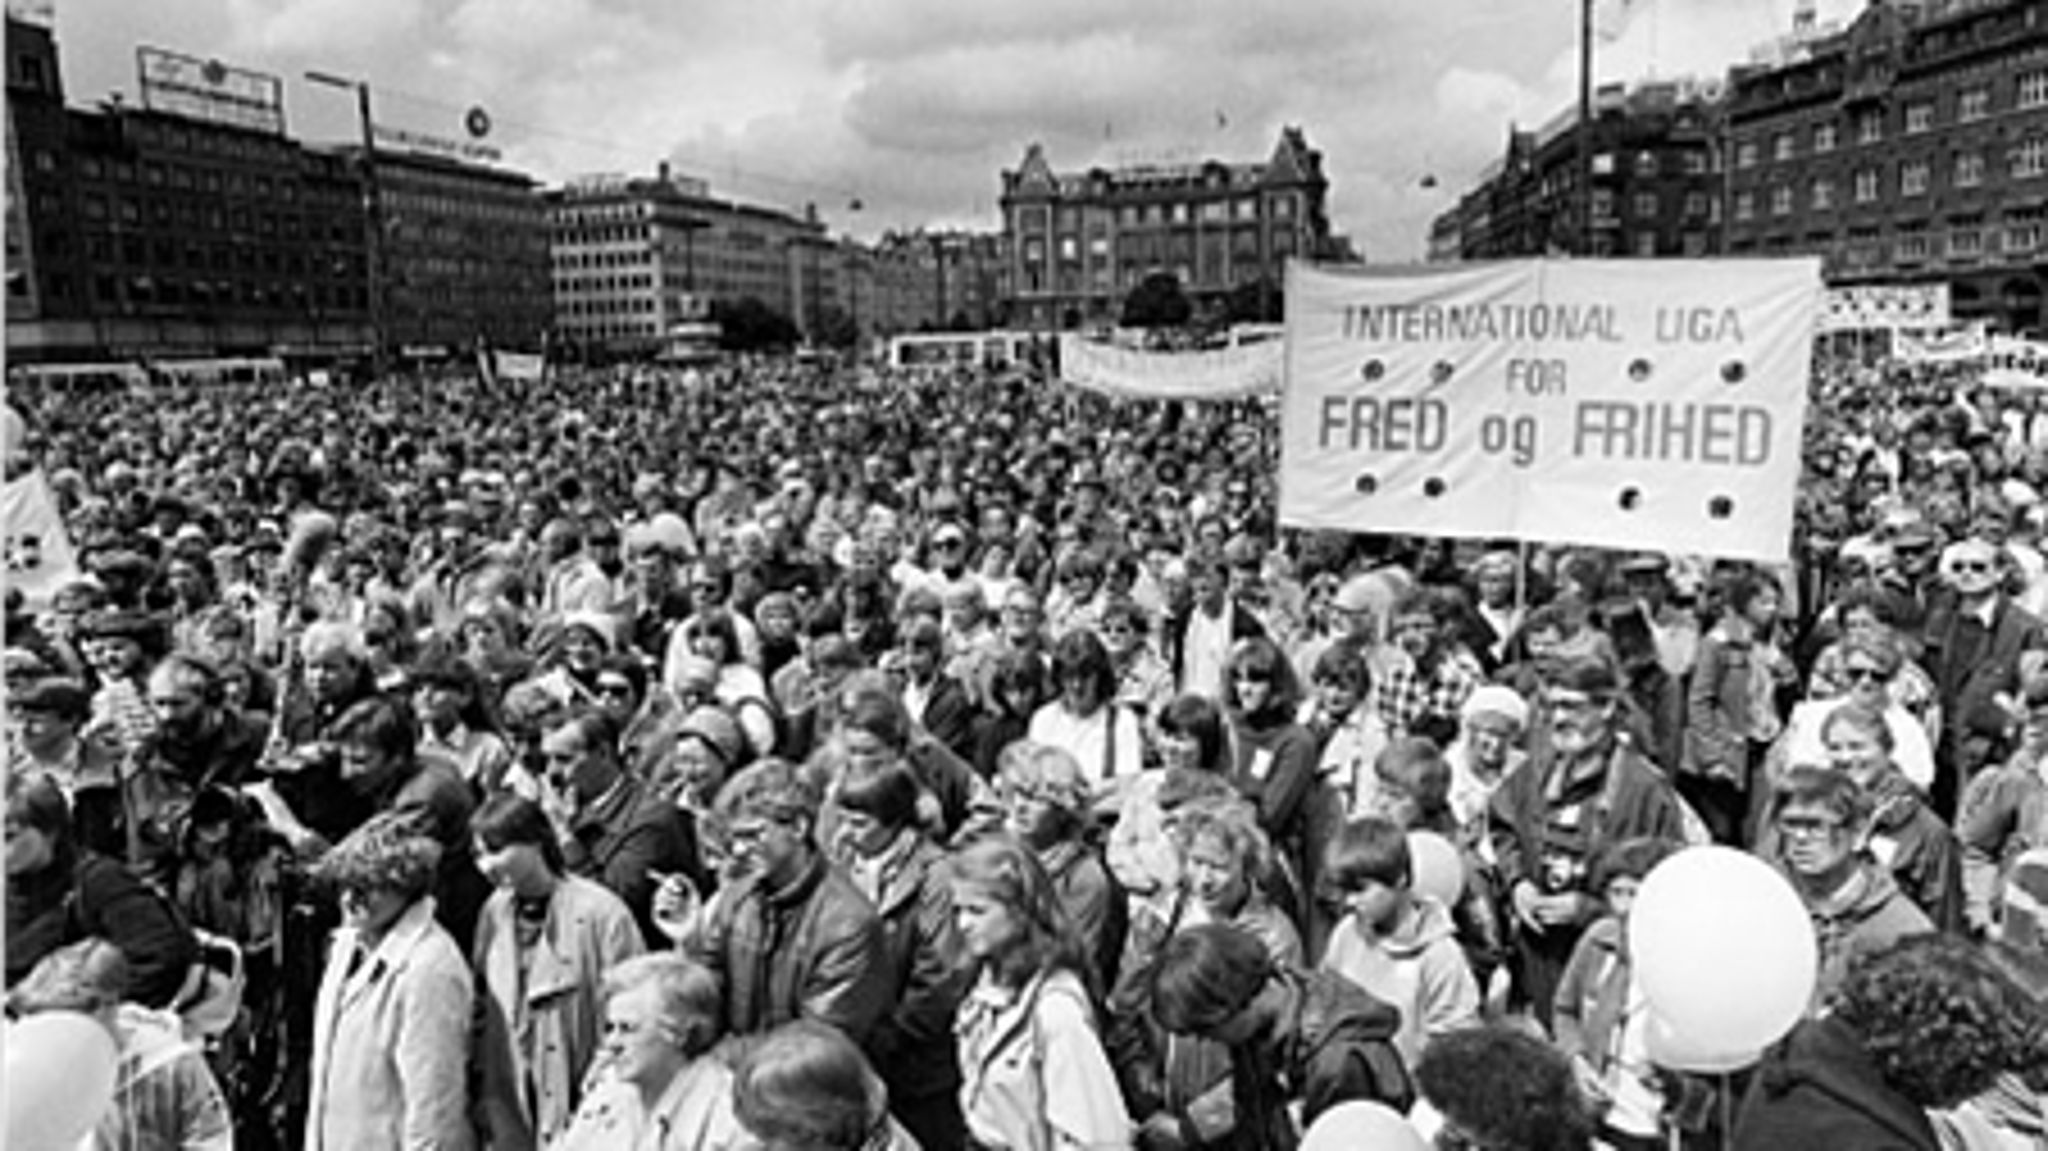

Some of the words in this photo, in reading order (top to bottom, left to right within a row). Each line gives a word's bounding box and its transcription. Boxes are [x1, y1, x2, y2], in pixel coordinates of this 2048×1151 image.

[1342, 304, 1623, 344] INTERNATIONAL
[1655, 308, 1745, 344] LIGA
[1506, 359, 1567, 397] FOR
[1318, 396, 1449, 453] FRED
[1480, 414, 1537, 466] og
[1572, 401, 1773, 466] FRIHED
